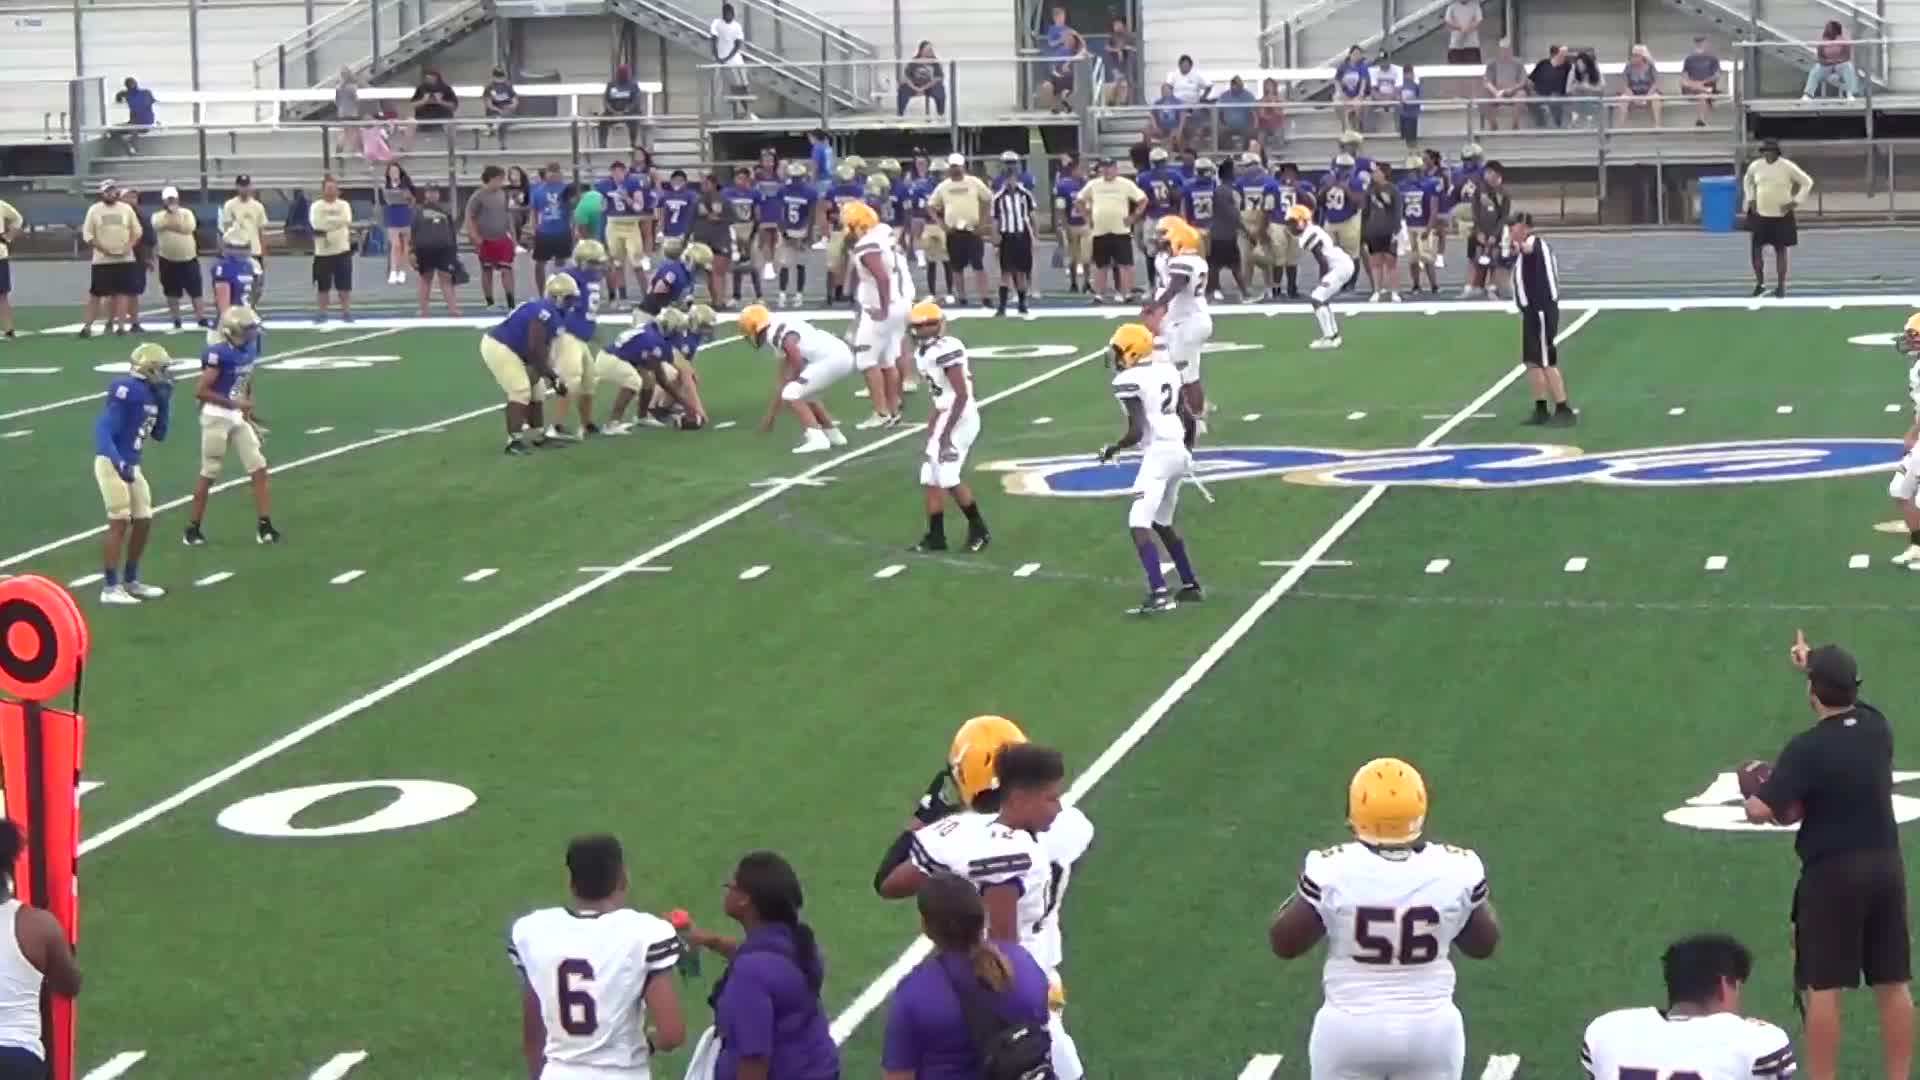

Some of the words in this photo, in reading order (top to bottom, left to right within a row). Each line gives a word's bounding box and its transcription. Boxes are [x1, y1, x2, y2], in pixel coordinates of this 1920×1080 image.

[1160, 383, 1173, 416] 2
[216, 779, 478, 837] 0
[1352, 906, 1441, 966] 56
[557, 958, 598, 1036] 6
